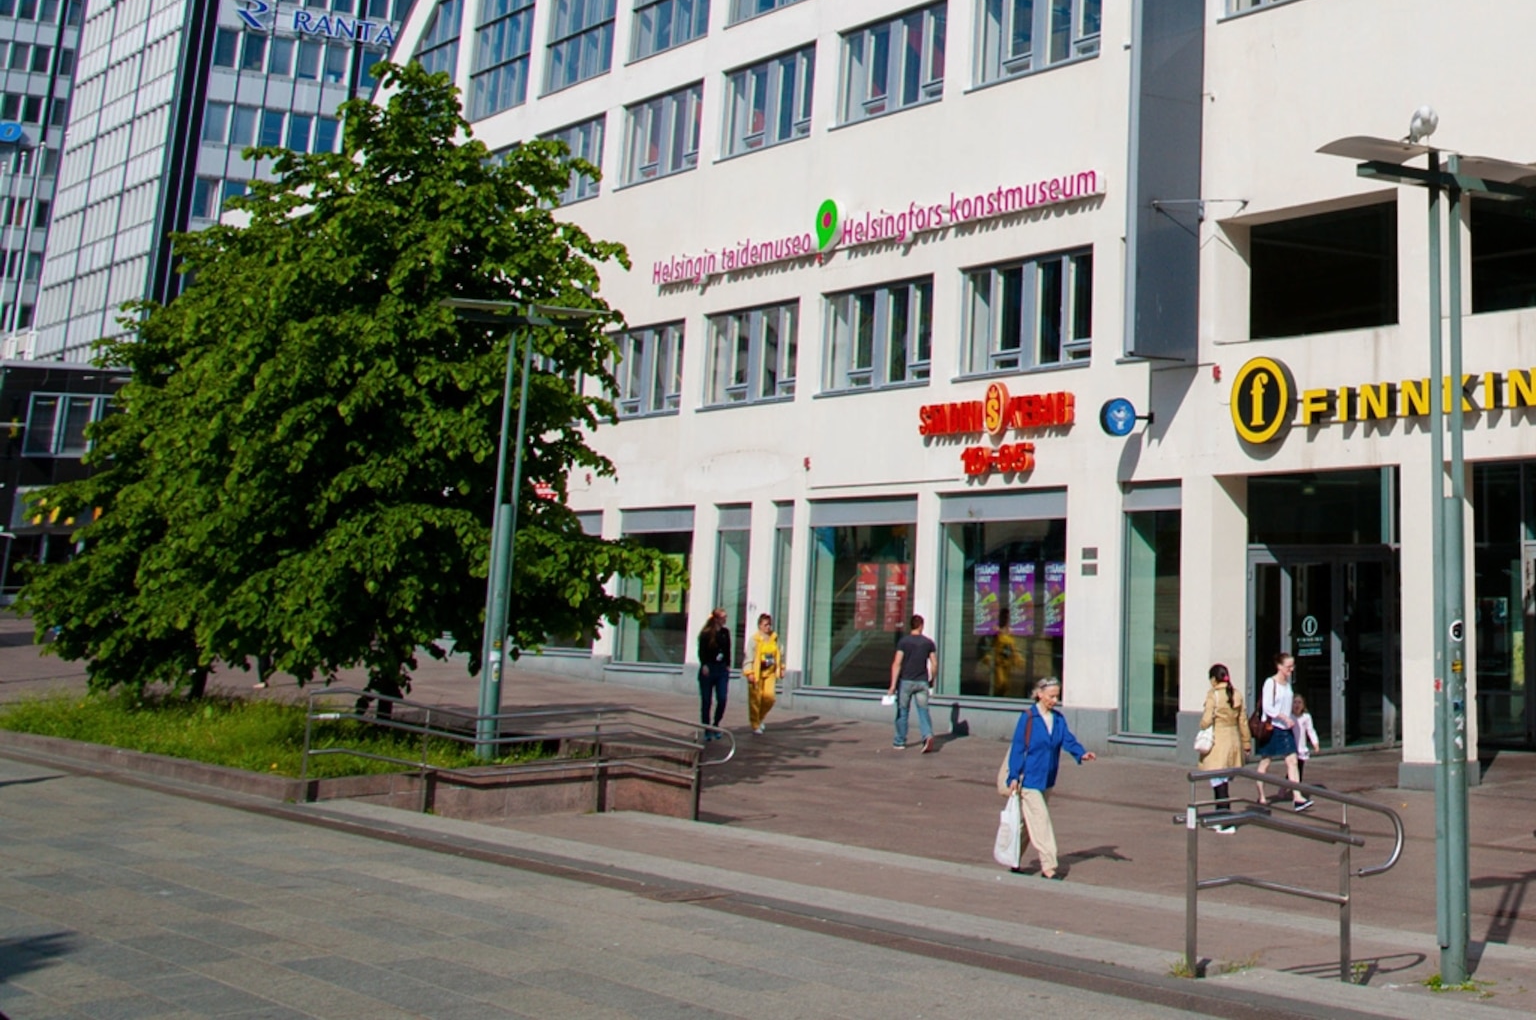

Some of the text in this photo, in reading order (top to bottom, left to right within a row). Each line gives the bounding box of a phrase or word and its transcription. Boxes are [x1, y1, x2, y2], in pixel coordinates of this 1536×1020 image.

[842, 168, 1097, 245] Helsingfors konstmuseum
[653, 232, 812, 284] Helsingin taidemuseo
